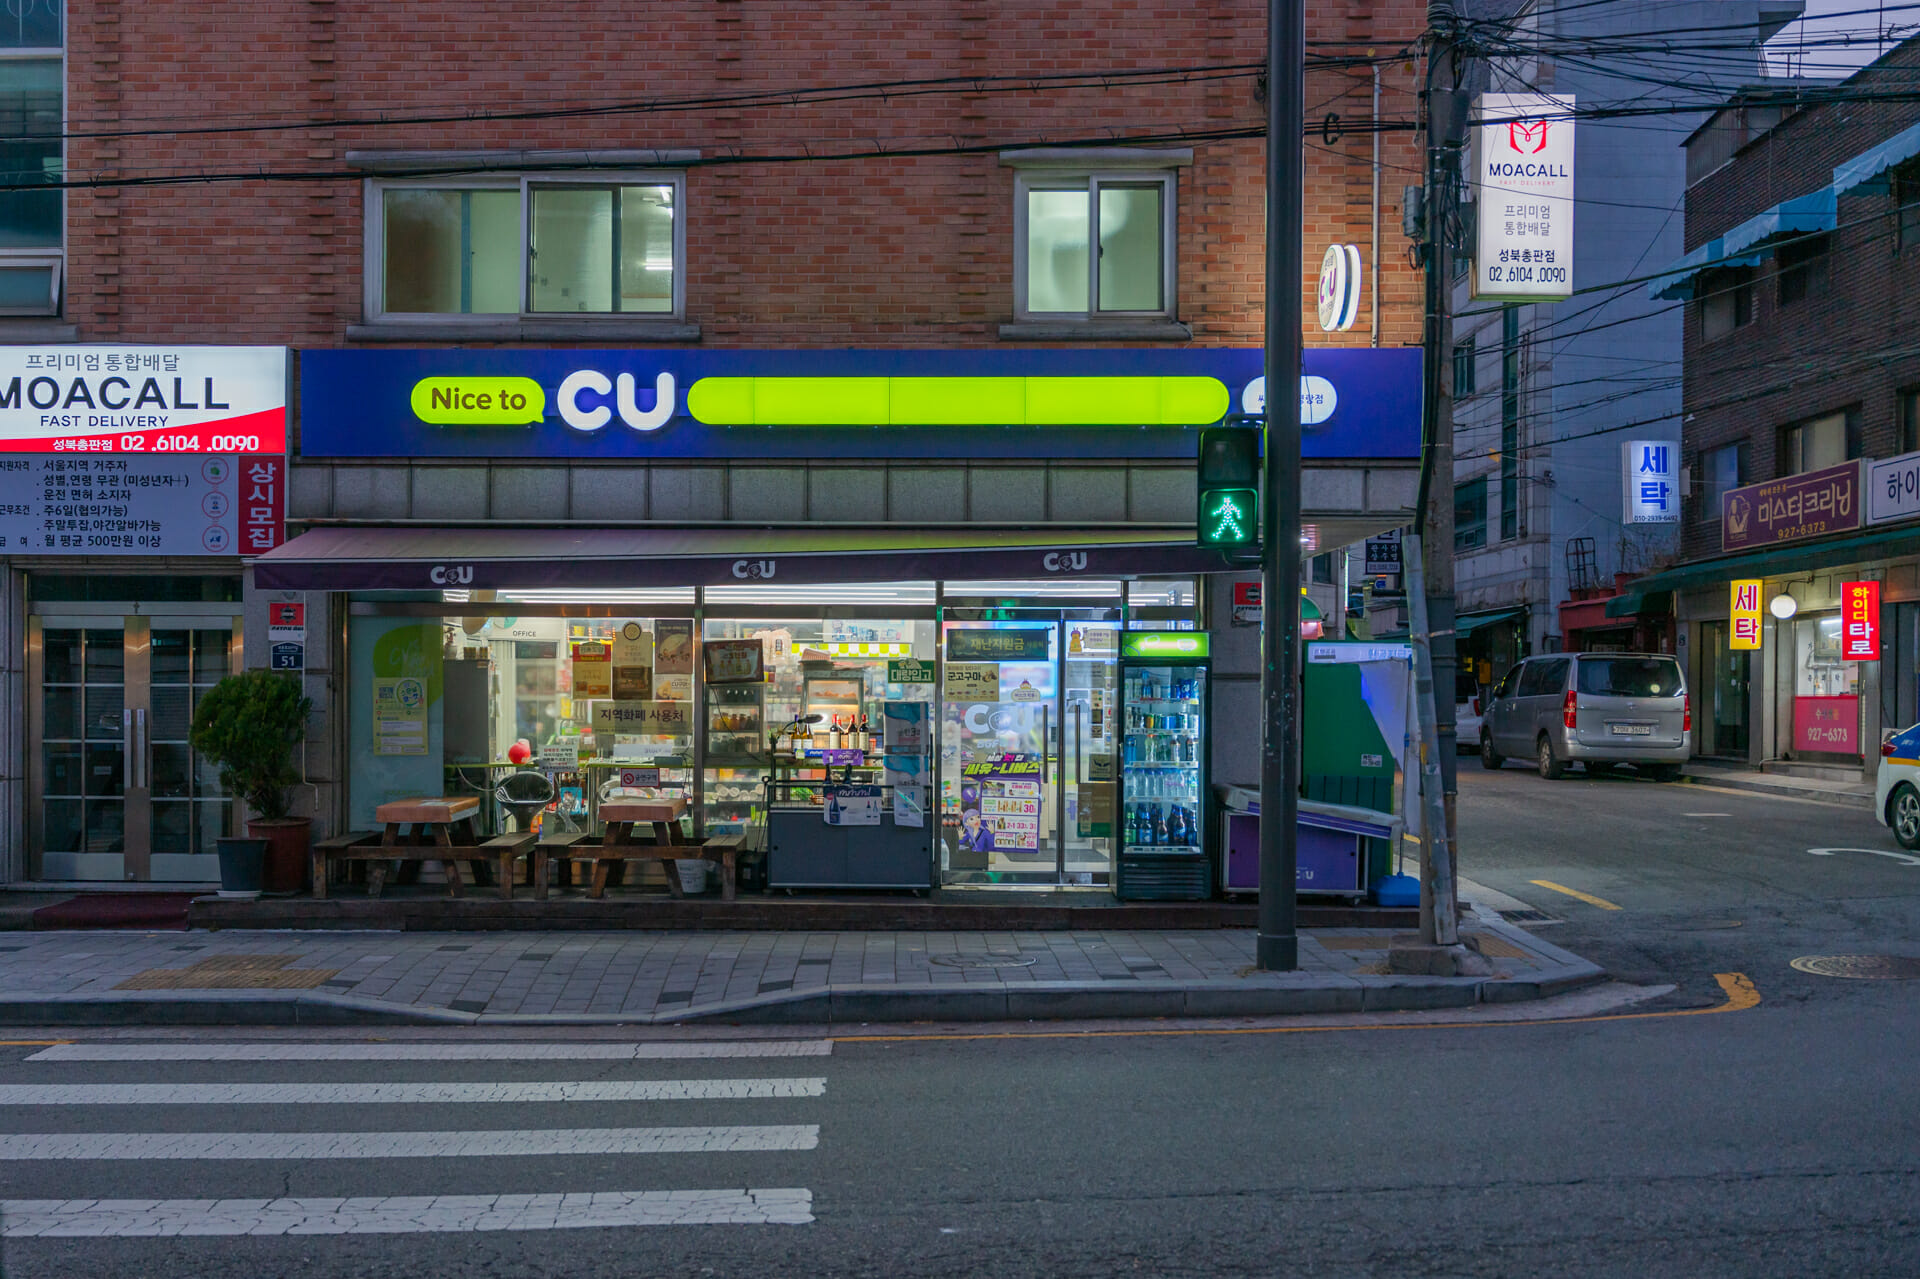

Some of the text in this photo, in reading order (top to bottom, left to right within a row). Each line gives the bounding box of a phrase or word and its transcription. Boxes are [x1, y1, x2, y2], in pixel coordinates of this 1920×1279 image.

[1488, 163, 1569, 178] MOACALL
[1503, 205, 1551, 219] 프리미엄
[1503, 221, 1551, 236] 통합배달
[1498, 249, 1556, 264] 성북총판점
[431, 387, 527, 411] Nice to
[556, 369, 676, 431] CU
[40, 415, 169, 428] FAST DELIVERY
[52, 438, 114, 452] 성북총판점
[43, 460, 89, 472] 서울지역
[93, 460, 128, 472] 거주자
[43, 474, 92, 487] 성별,연령
[96, 475, 120, 487] 무관
[1639, 445, 1671, 512] 세탁
[1886, 466, 1920, 505] 하이
[43, 488, 132, 502] 운전 면허 소지자
[247, 462, 277, 549] 상시모집
[1757, 478, 1852, 531] 미스터크리닝
[44, 534, 55, 547] 월
[60, 534, 83, 548] 평균
[87, 534, 135, 548] 500만원
[139, 534, 162, 548] 이상
[731, 559, 776, 579] CU
[1043, 551, 1088, 572] CU
[429, 565, 474, 584] CU
[1734, 584, 1760, 645] 세탁
[512, 630, 537, 638] OFFICE
[970, 637, 1025, 651] 재난지원금
[281, 655, 295, 667] 51
[600, 709, 684, 722] 지역화폐 사용처
[964, 704, 1035, 735] CU
[1807, 727, 1848, 742] 927-6373
